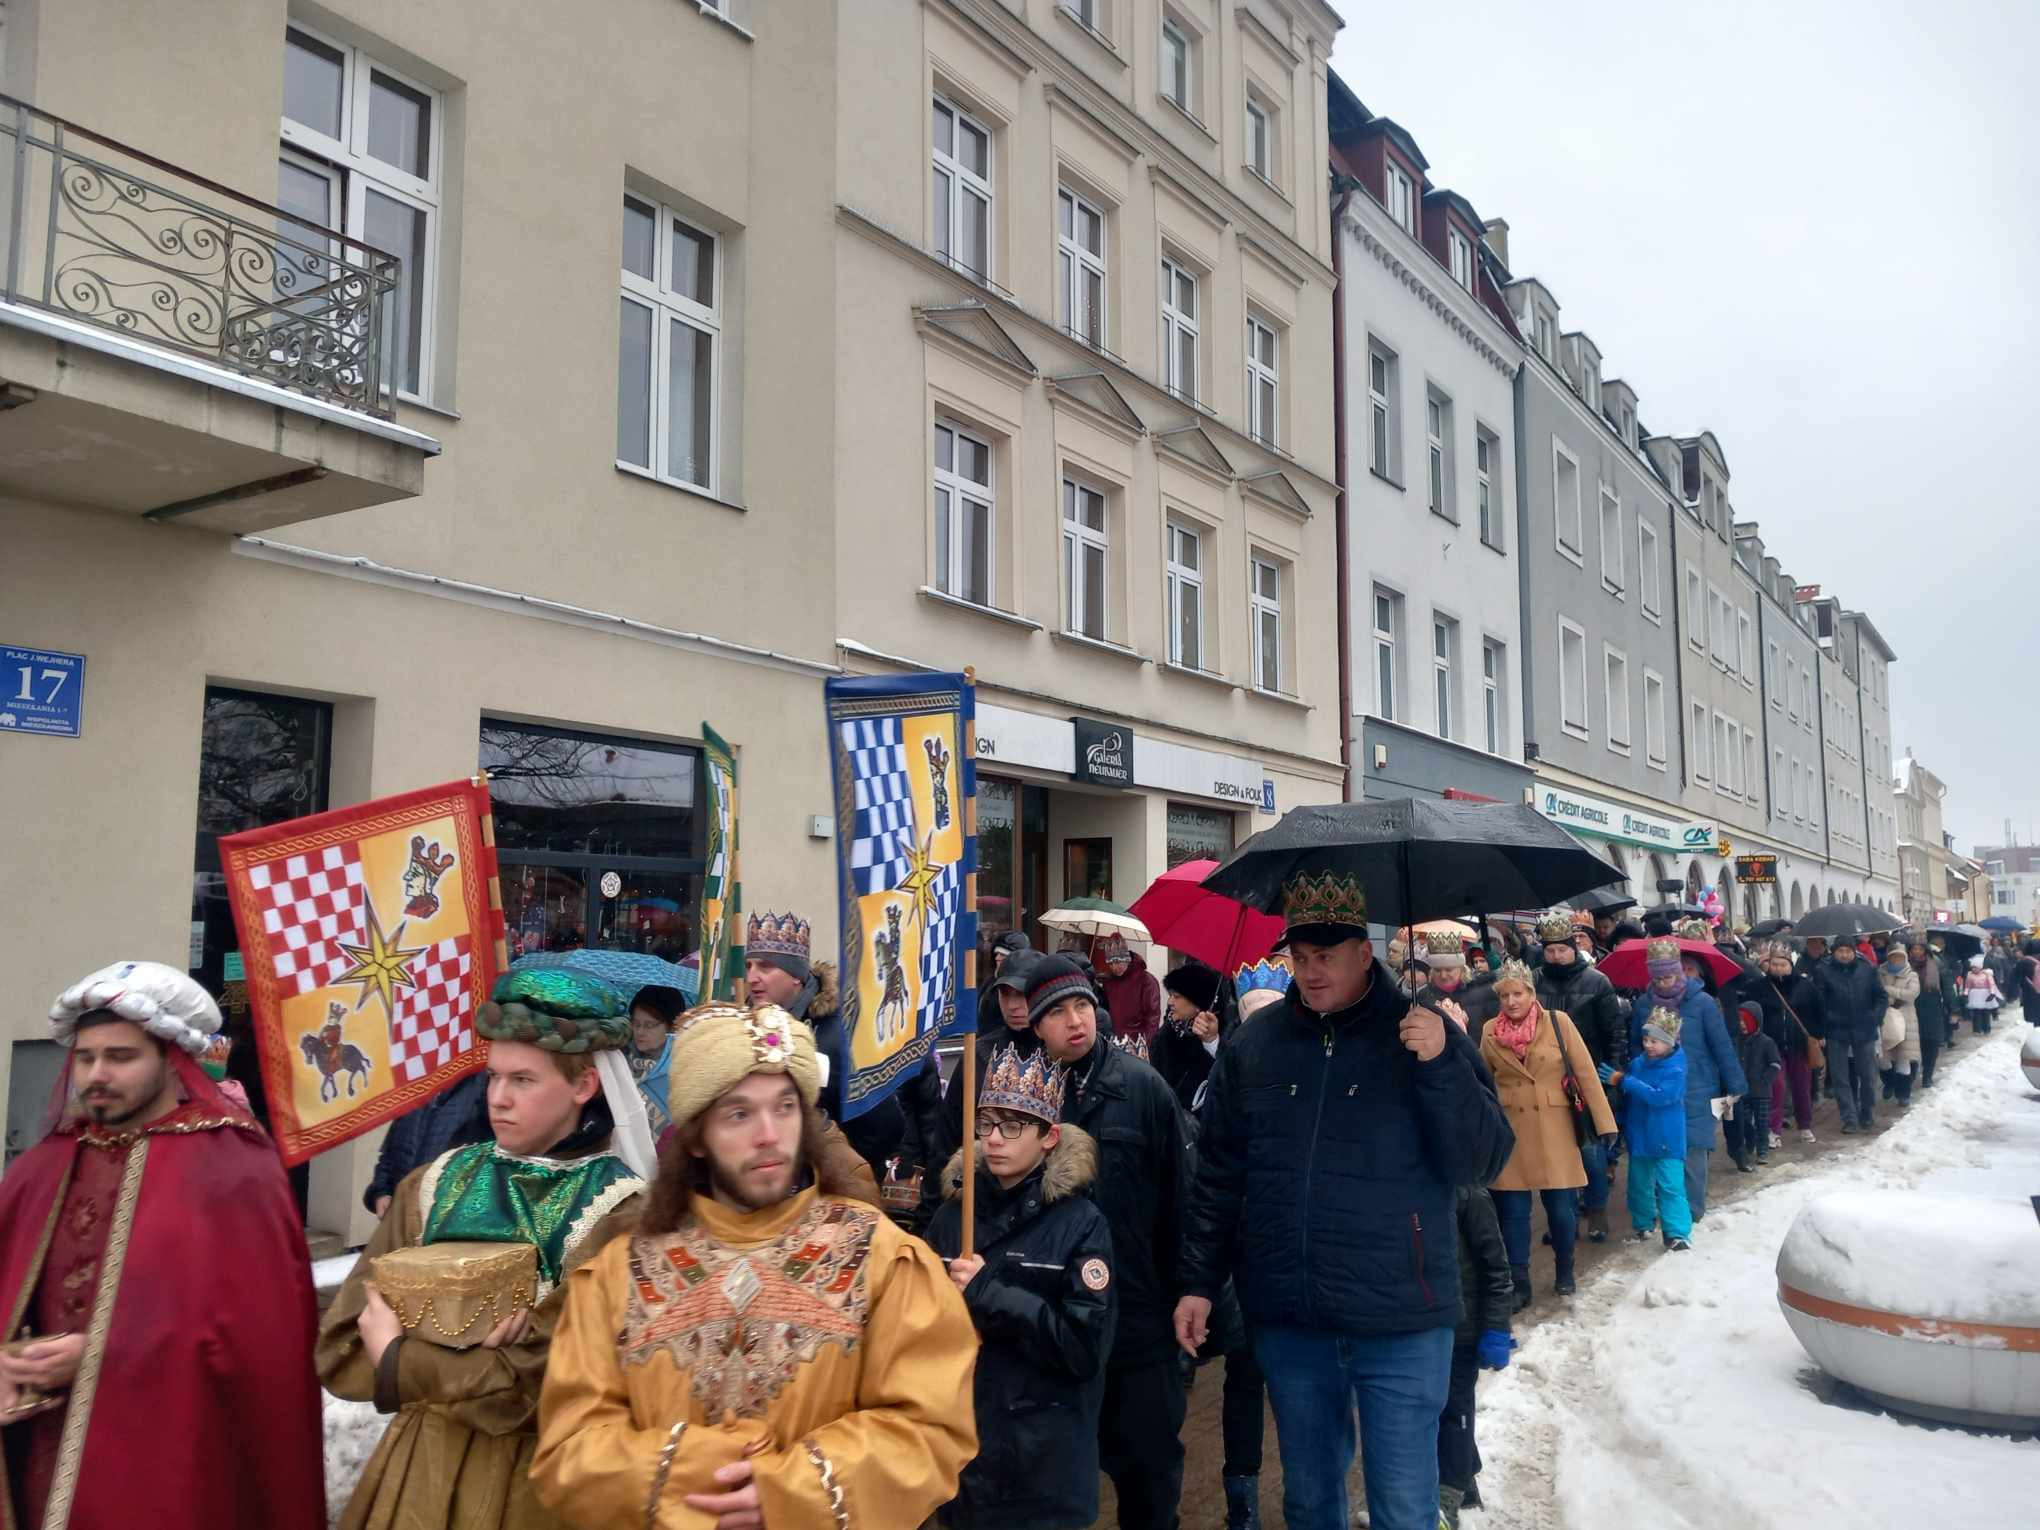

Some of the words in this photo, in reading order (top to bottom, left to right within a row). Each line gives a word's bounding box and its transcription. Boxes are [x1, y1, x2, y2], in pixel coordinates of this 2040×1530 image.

[15, 666, 68, 704] 17
[1214, 782, 1240, 798] DESIGN
[1245, 787, 1262, 802] FOLK
[1558, 799, 1581, 817] CRÉDIT
[1581, 806, 1609, 825] AGRICOLE
[1649, 824, 1671, 841] AGRICOLE
